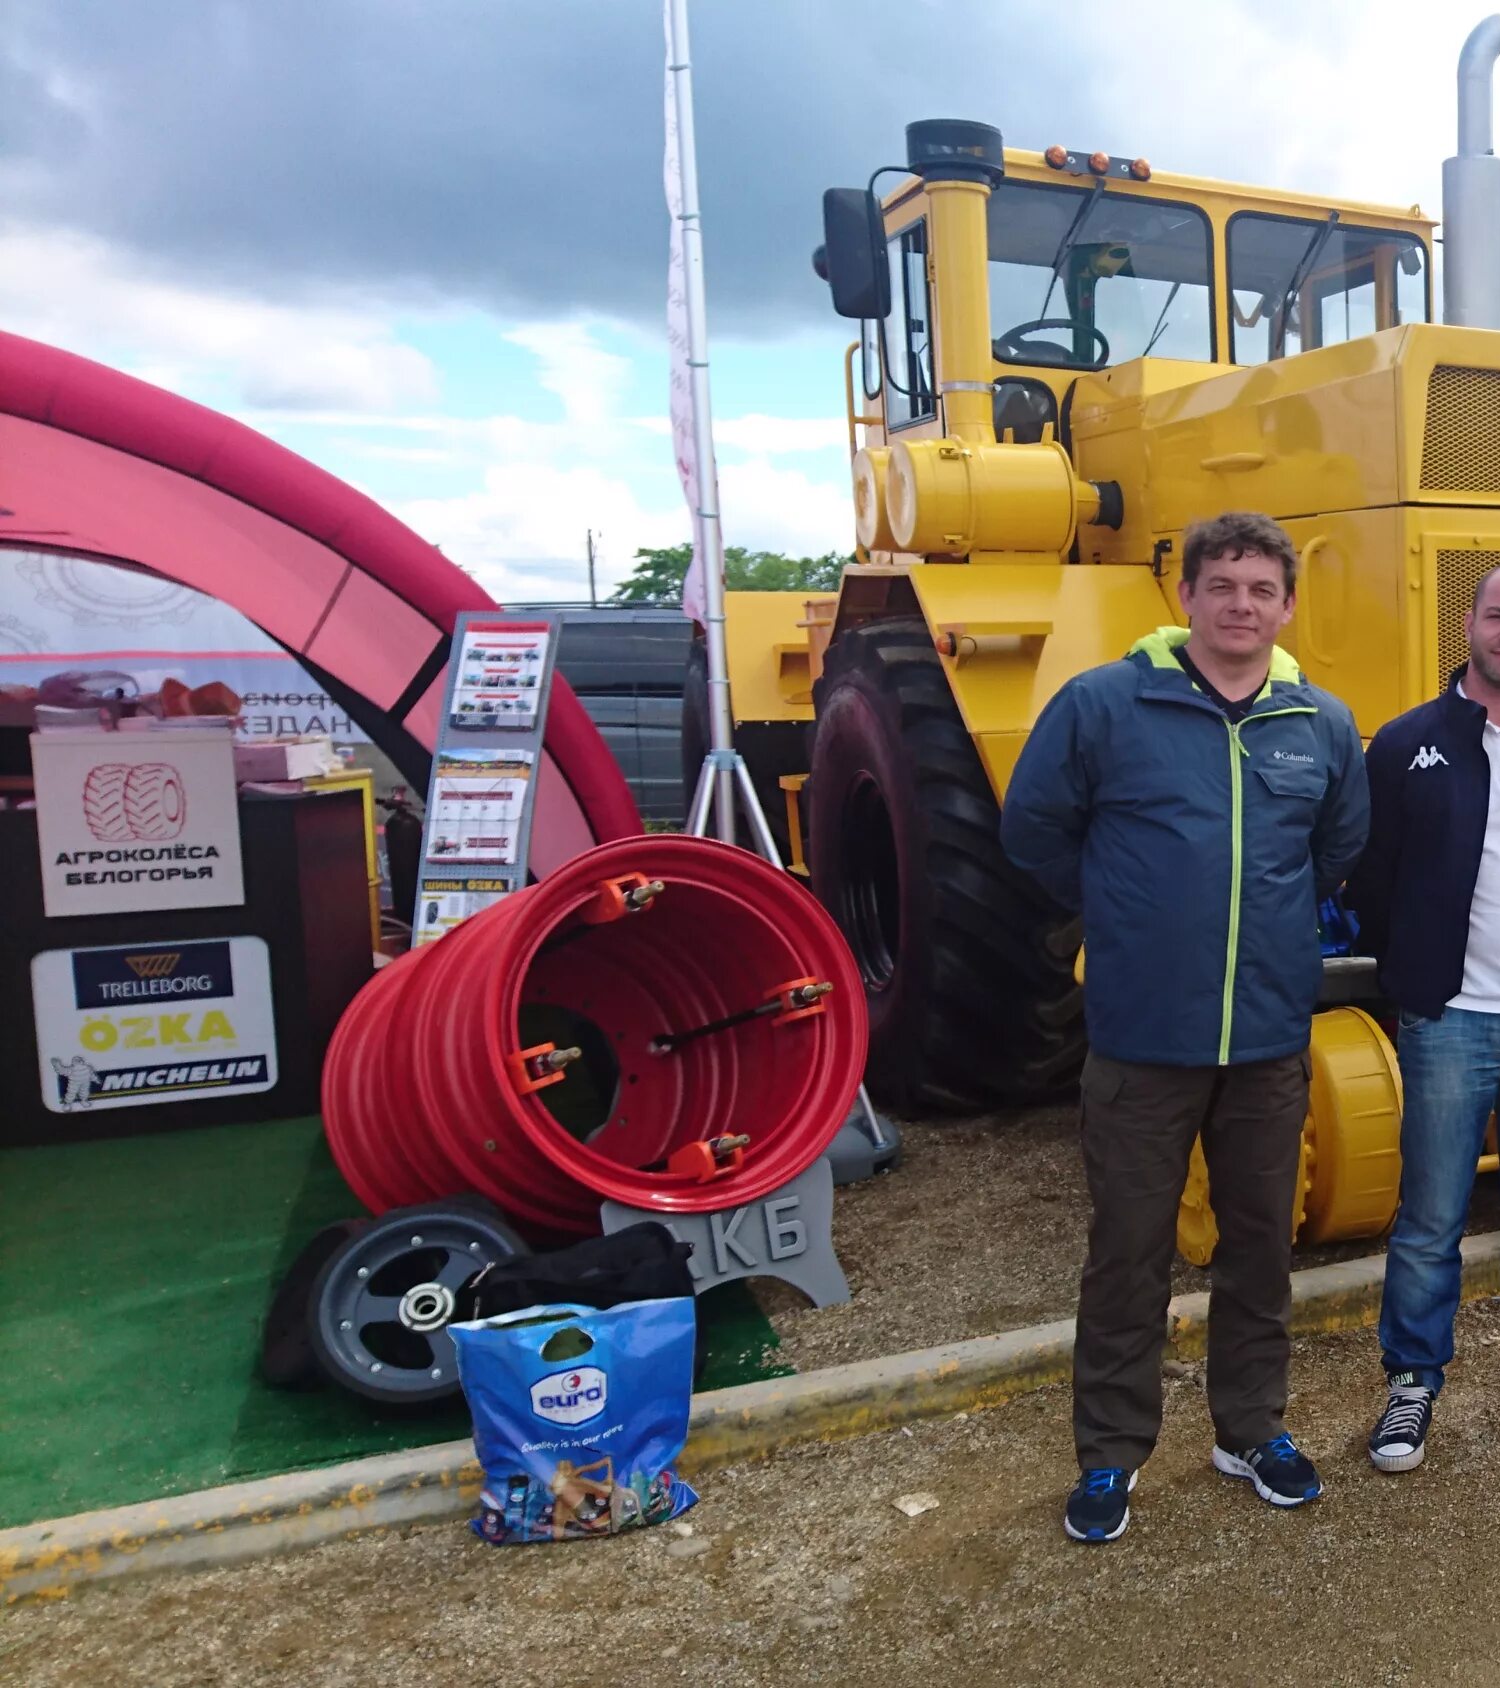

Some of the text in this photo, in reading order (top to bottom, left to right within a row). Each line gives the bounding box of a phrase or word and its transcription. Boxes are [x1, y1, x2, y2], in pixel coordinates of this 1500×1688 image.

[1281, 751, 1314, 763] Columbia
[56, 844, 220, 866] АГРОКОЛЁСА
[65, 866, 213, 886] БЕЛОГОРЬЯ
[98, 974, 212, 999] TRELLEBORG
[79, 1010, 238, 1053] ÖZKA
[100, 1060, 262, 1091] MICHELIN
[521, 1442, 559, 1454] Quality
[561, 1440, 570, 1448] is
[572, 1439, 580, 1447] in
[582, 1434, 601, 1446] our
